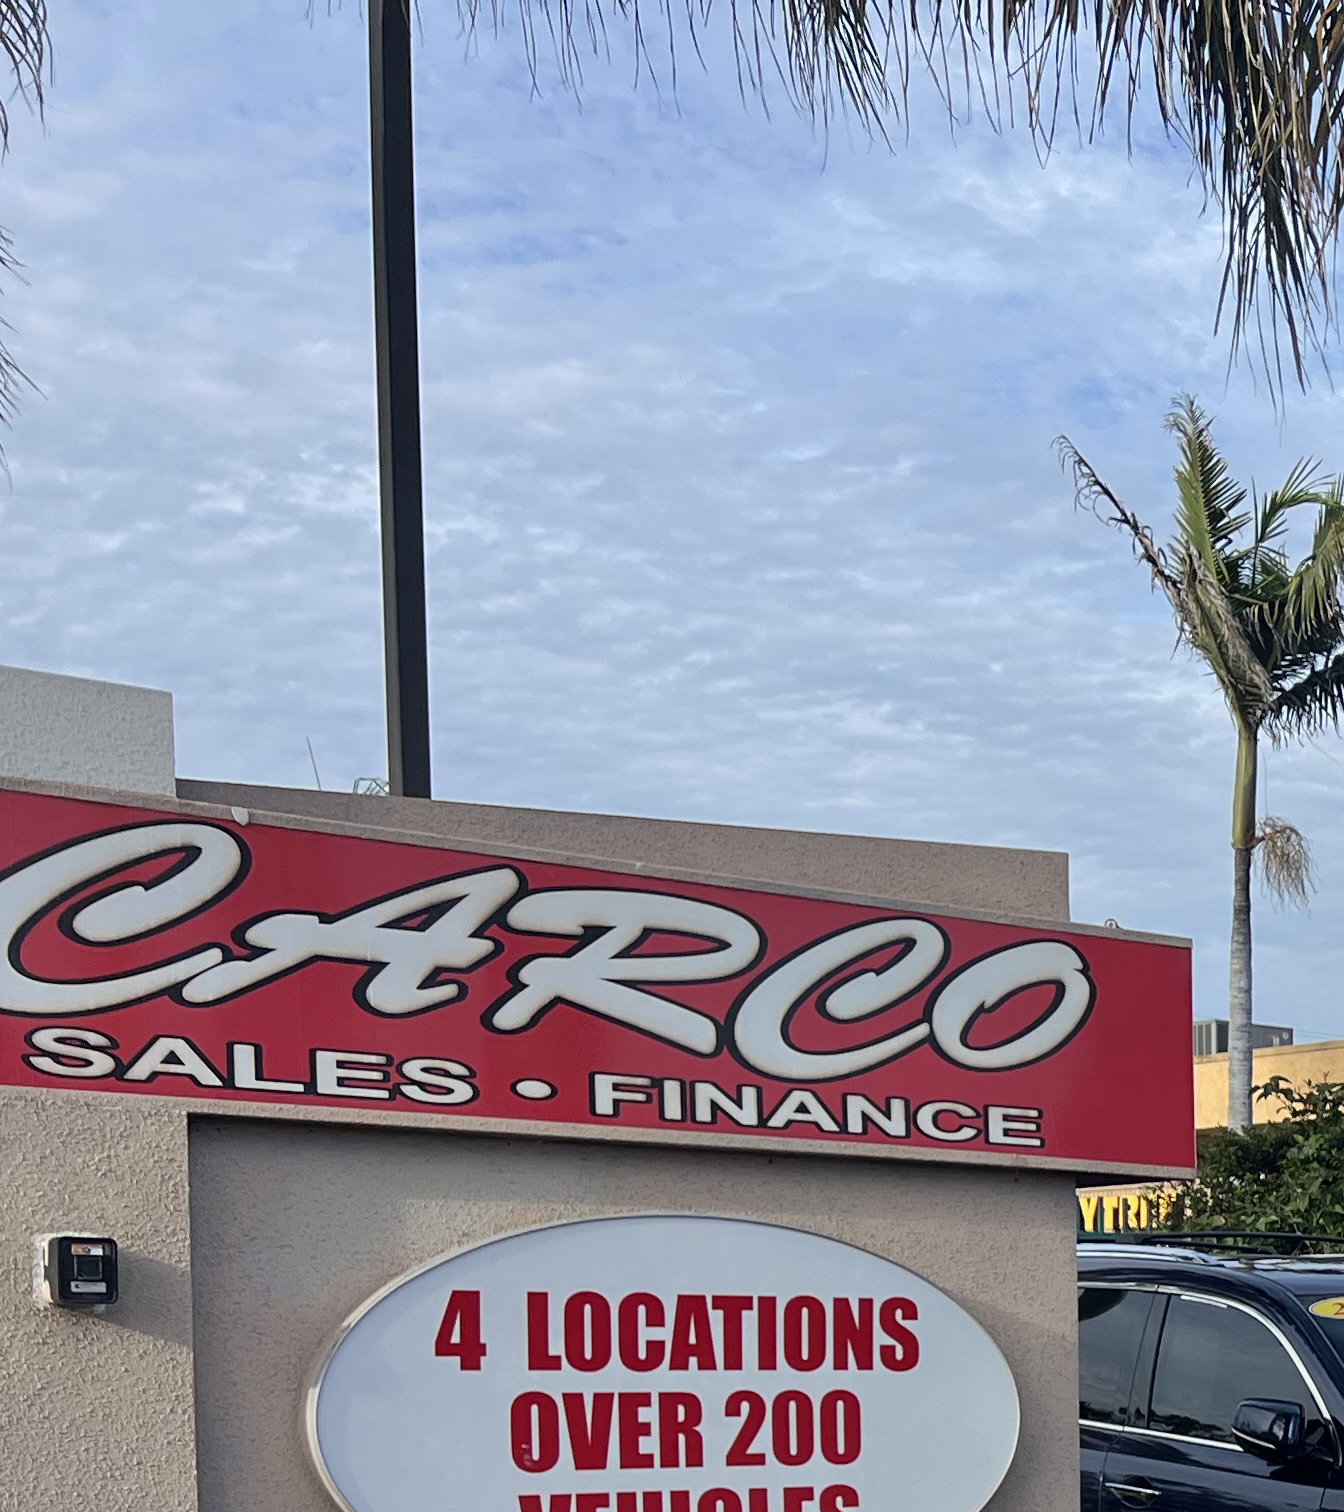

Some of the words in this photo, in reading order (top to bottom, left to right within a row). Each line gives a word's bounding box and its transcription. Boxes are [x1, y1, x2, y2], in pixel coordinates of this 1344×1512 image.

[0, 820, 1093, 1081] CARCO
[25, 1024, 479, 1104] SALES
[589, 1070, 1045, 1148] FINANCE
[433, 1289, 488, 1372] 4
[526, 1291, 921, 1374] LOCATIONS
[510, 1390, 704, 1474] OVER
[724, 1389, 863, 1467] 200
